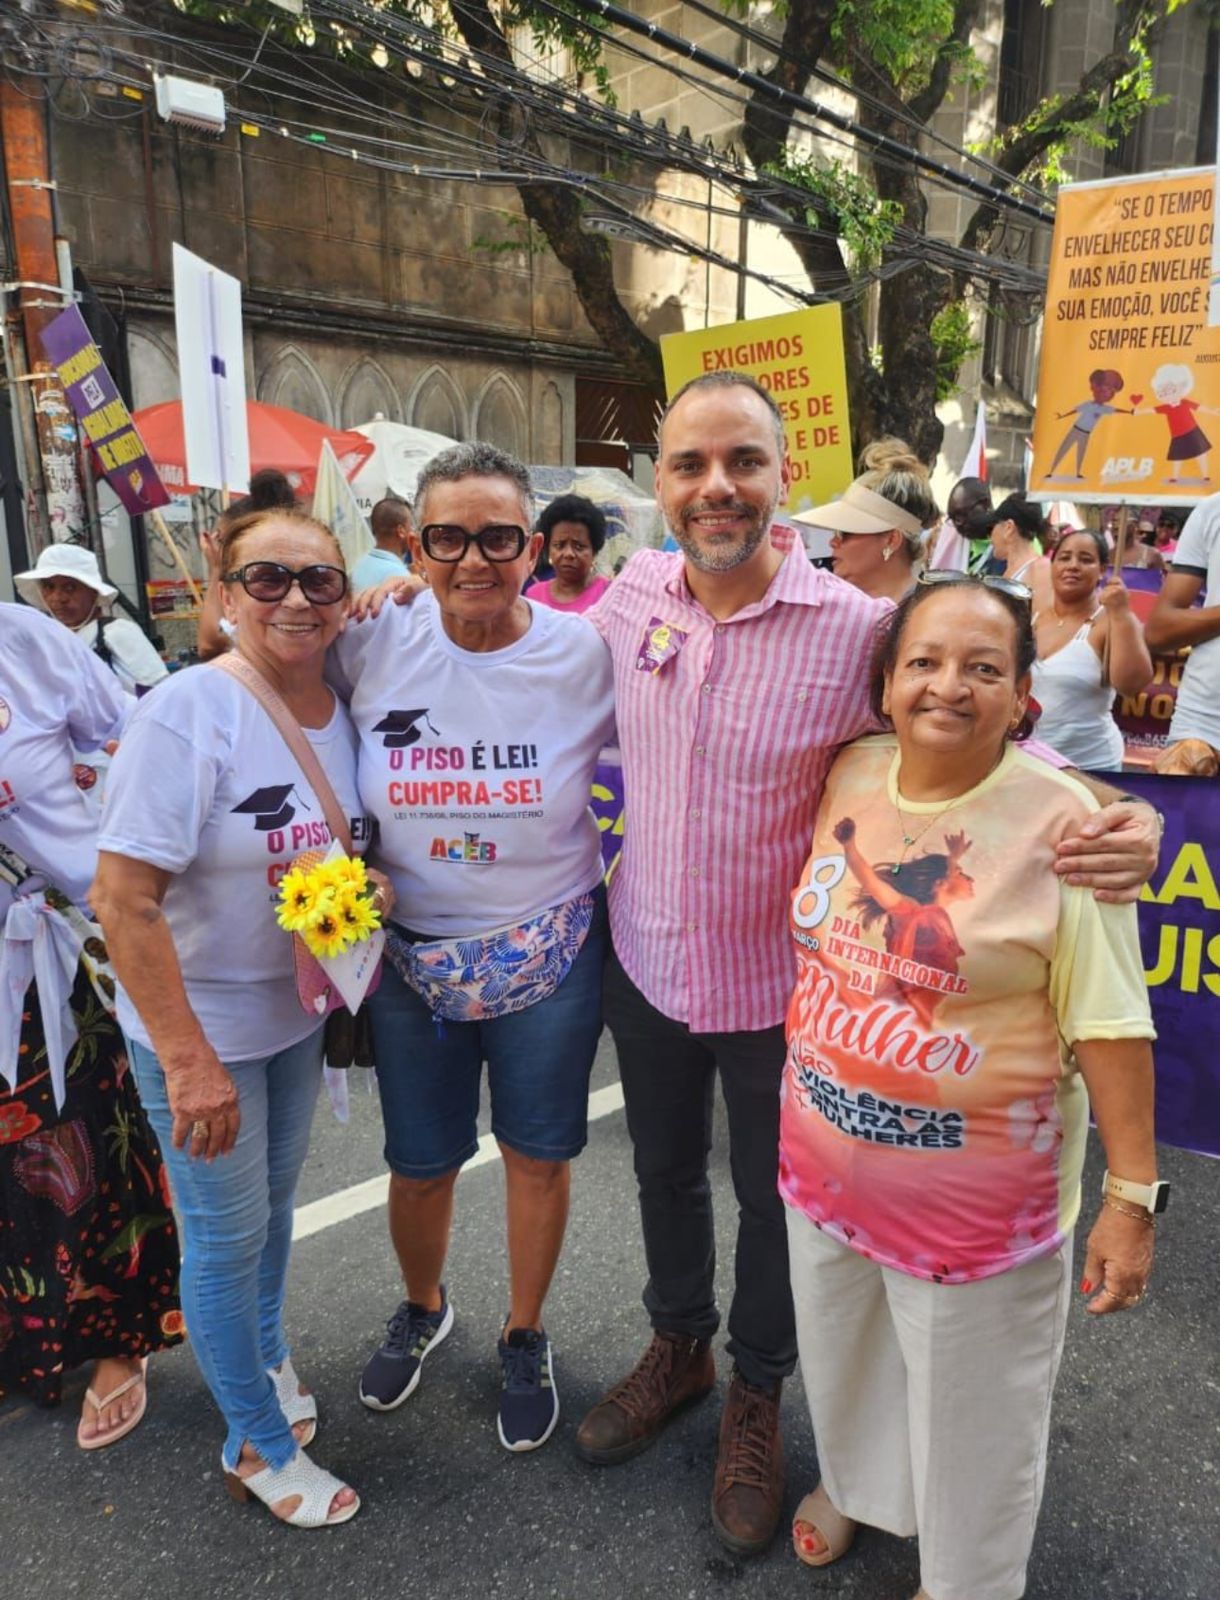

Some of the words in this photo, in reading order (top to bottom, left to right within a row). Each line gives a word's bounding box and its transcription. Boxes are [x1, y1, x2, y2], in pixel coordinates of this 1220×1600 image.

[1144, 195, 1154, 217] O
[1159, 188, 1213, 216] TEMPO
[1064, 228, 1160, 258] ENVELHECER
[1164, 225, 1195, 249] SEU
[1068, 266, 1102, 290] MAS
[1105, 261, 1137, 287] NÃO
[1140, 256, 1212, 284] ENVELHE
[1057, 300, 1085, 321] SUA
[1160, 287, 1201, 315] VOCÊ
[702, 335, 804, 372] EXIGIMOS
[1089, 328, 1147, 351] SEMPRE
[758, 367, 810, 393] ORES
[807, 395, 834, 418] DE
[796, 430, 807, 451] E
[813, 425, 840, 448] DE
[1101, 456, 1154, 478] APLB
[389, 749, 403, 771] O
[411, 746, 465, 771] PISO
[472, 740, 486, 770] É
[493, 744, 538, 769] LEI!
[388, 779, 543, 806] CUMPRA-SE!
[267, 831, 284, 854] O
[430, 837, 497, 862] ACEB
[792, 854, 847, 929] 8
[831, 917, 861, 940] DIA
[826, 937, 968, 994] INTERNACIONAL
[850, 969, 874, 993] DA
[787, 955, 979, 1076] Mulher
[801, 1064, 963, 1123] VIOLÊNCIA
